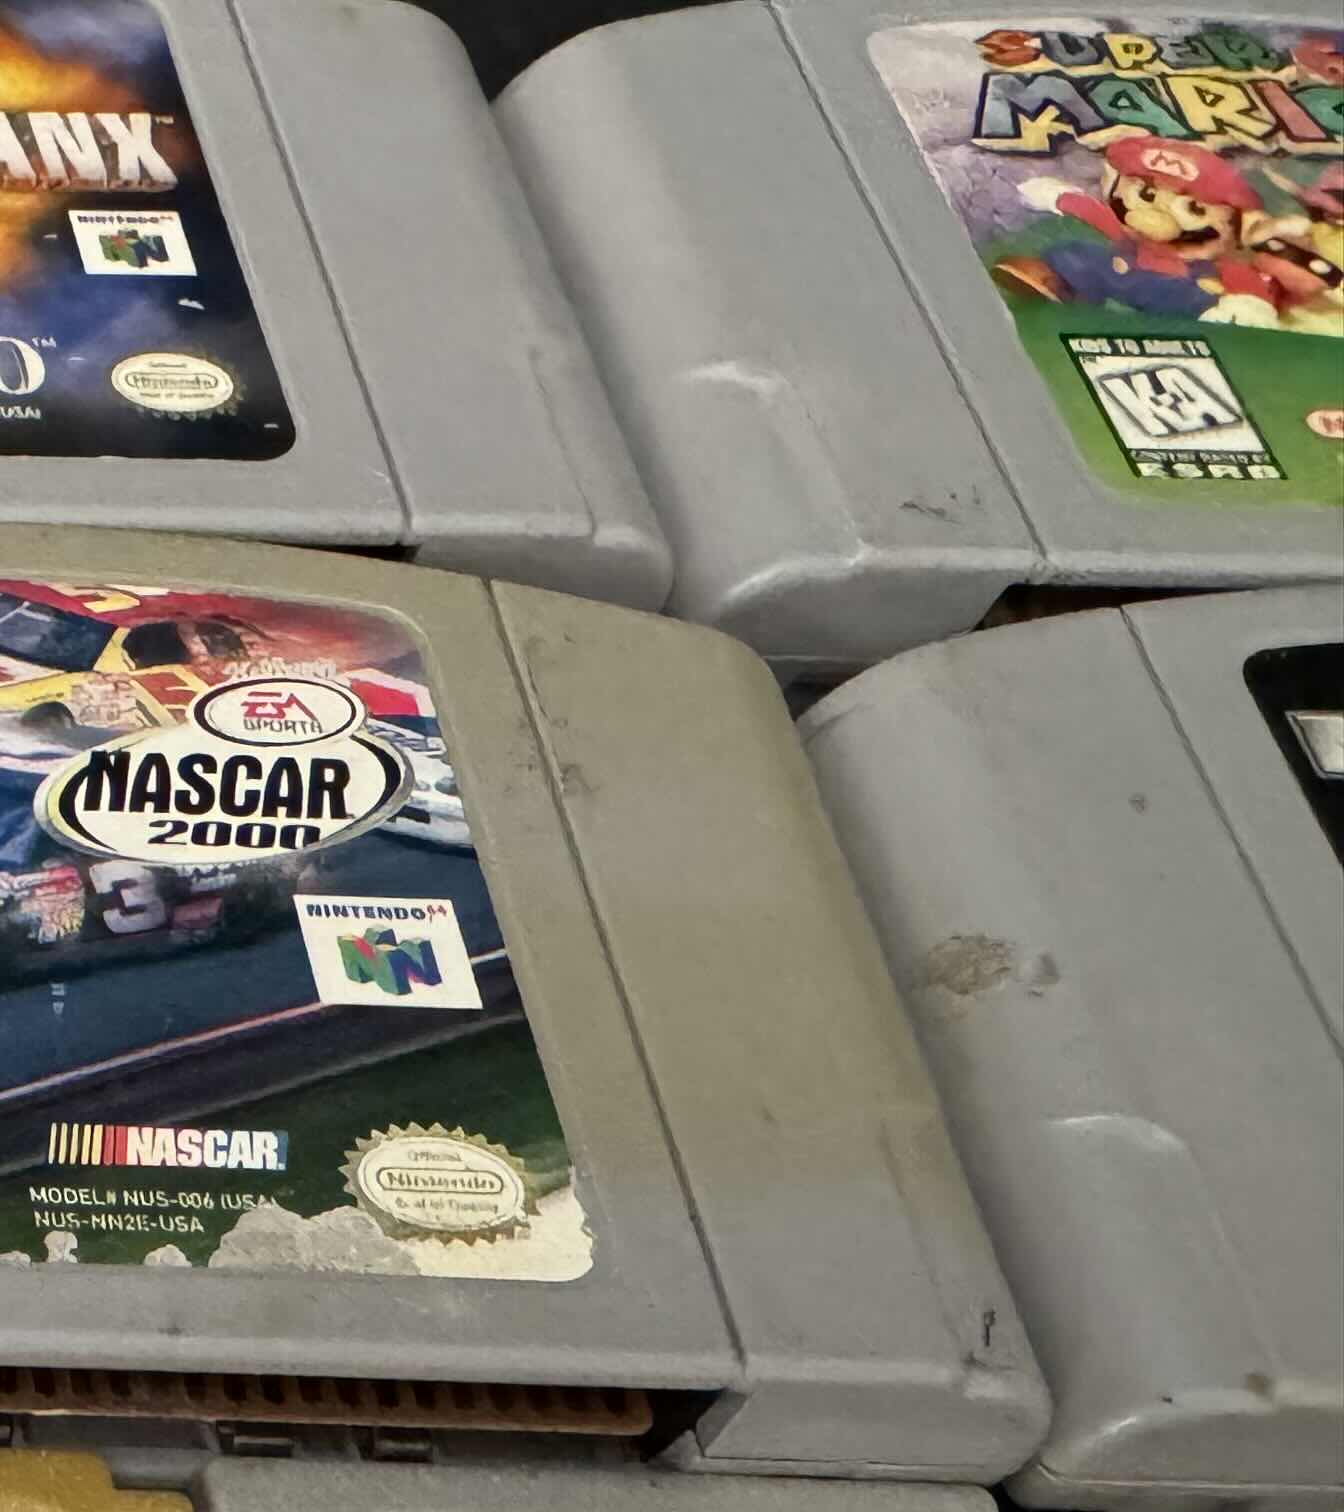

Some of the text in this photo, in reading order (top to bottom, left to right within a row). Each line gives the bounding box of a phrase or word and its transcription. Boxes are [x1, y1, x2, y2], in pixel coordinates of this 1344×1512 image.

[974, 27, 1284, 72] SUPER
[82, 748, 356, 821] NASCAR
[147, 819, 321, 850] 2000
[89, 858, 169, 934] 3
[306, 903, 427, 921] NINTENDO
[126, 1126, 287, 1171] NASCAR
[122, 1189, 215, 1210] NUS-006
